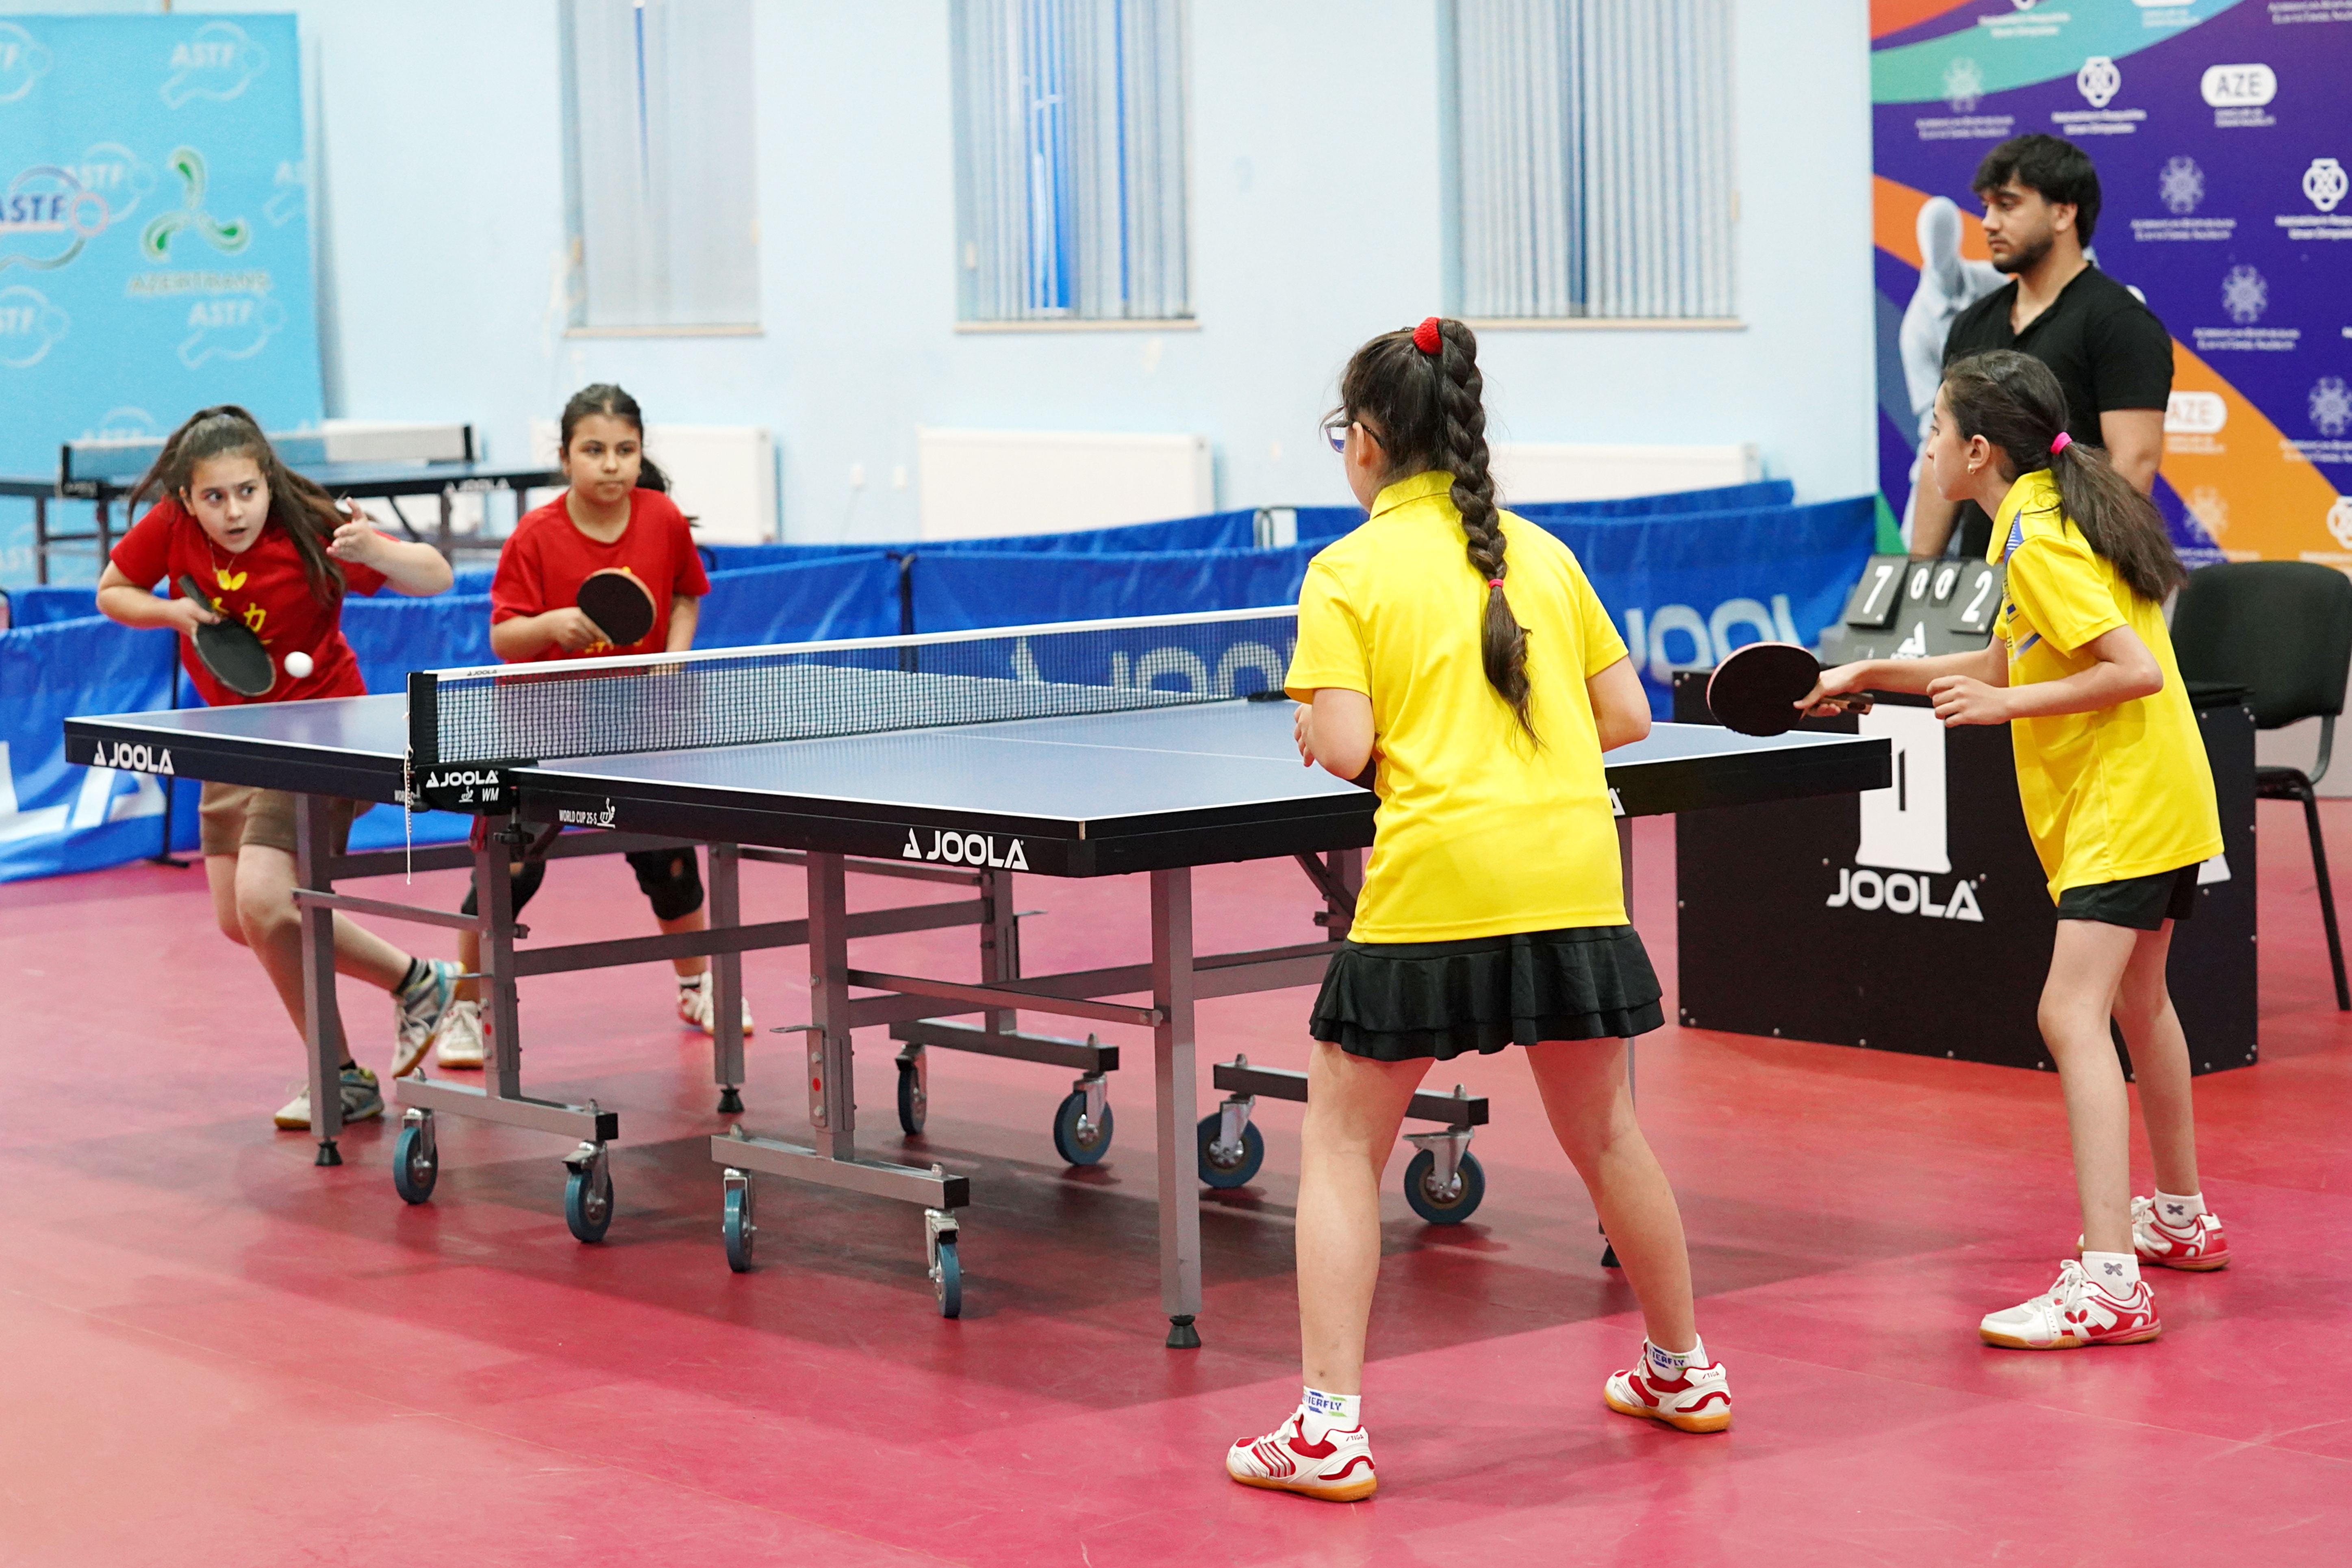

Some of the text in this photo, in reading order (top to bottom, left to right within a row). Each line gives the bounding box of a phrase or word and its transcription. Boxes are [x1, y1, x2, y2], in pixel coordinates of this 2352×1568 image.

[170, 42, 236, 67] ASTF
[2216, 72, 2262, 98] AZE
[188, 301, 254, 325] ASTF
[1863, 565, 1894, 614] 7
[1910, 568, 1929, 600] 0
[1934, 568, 1955, 600] 0
[1961, 570, 1993, 623] 2
[109, 742, 174, 775] JOOLA
[440, 769, 499, 787] JOOLA
[482, 787, 500, 802] WM
[559, 809, 576, 823] WORLD
[576, 810, 586, 823] CUP
[926, 830, 1029, 871] JOOLA
[1825, 868, 1984, 922] JOOLA
